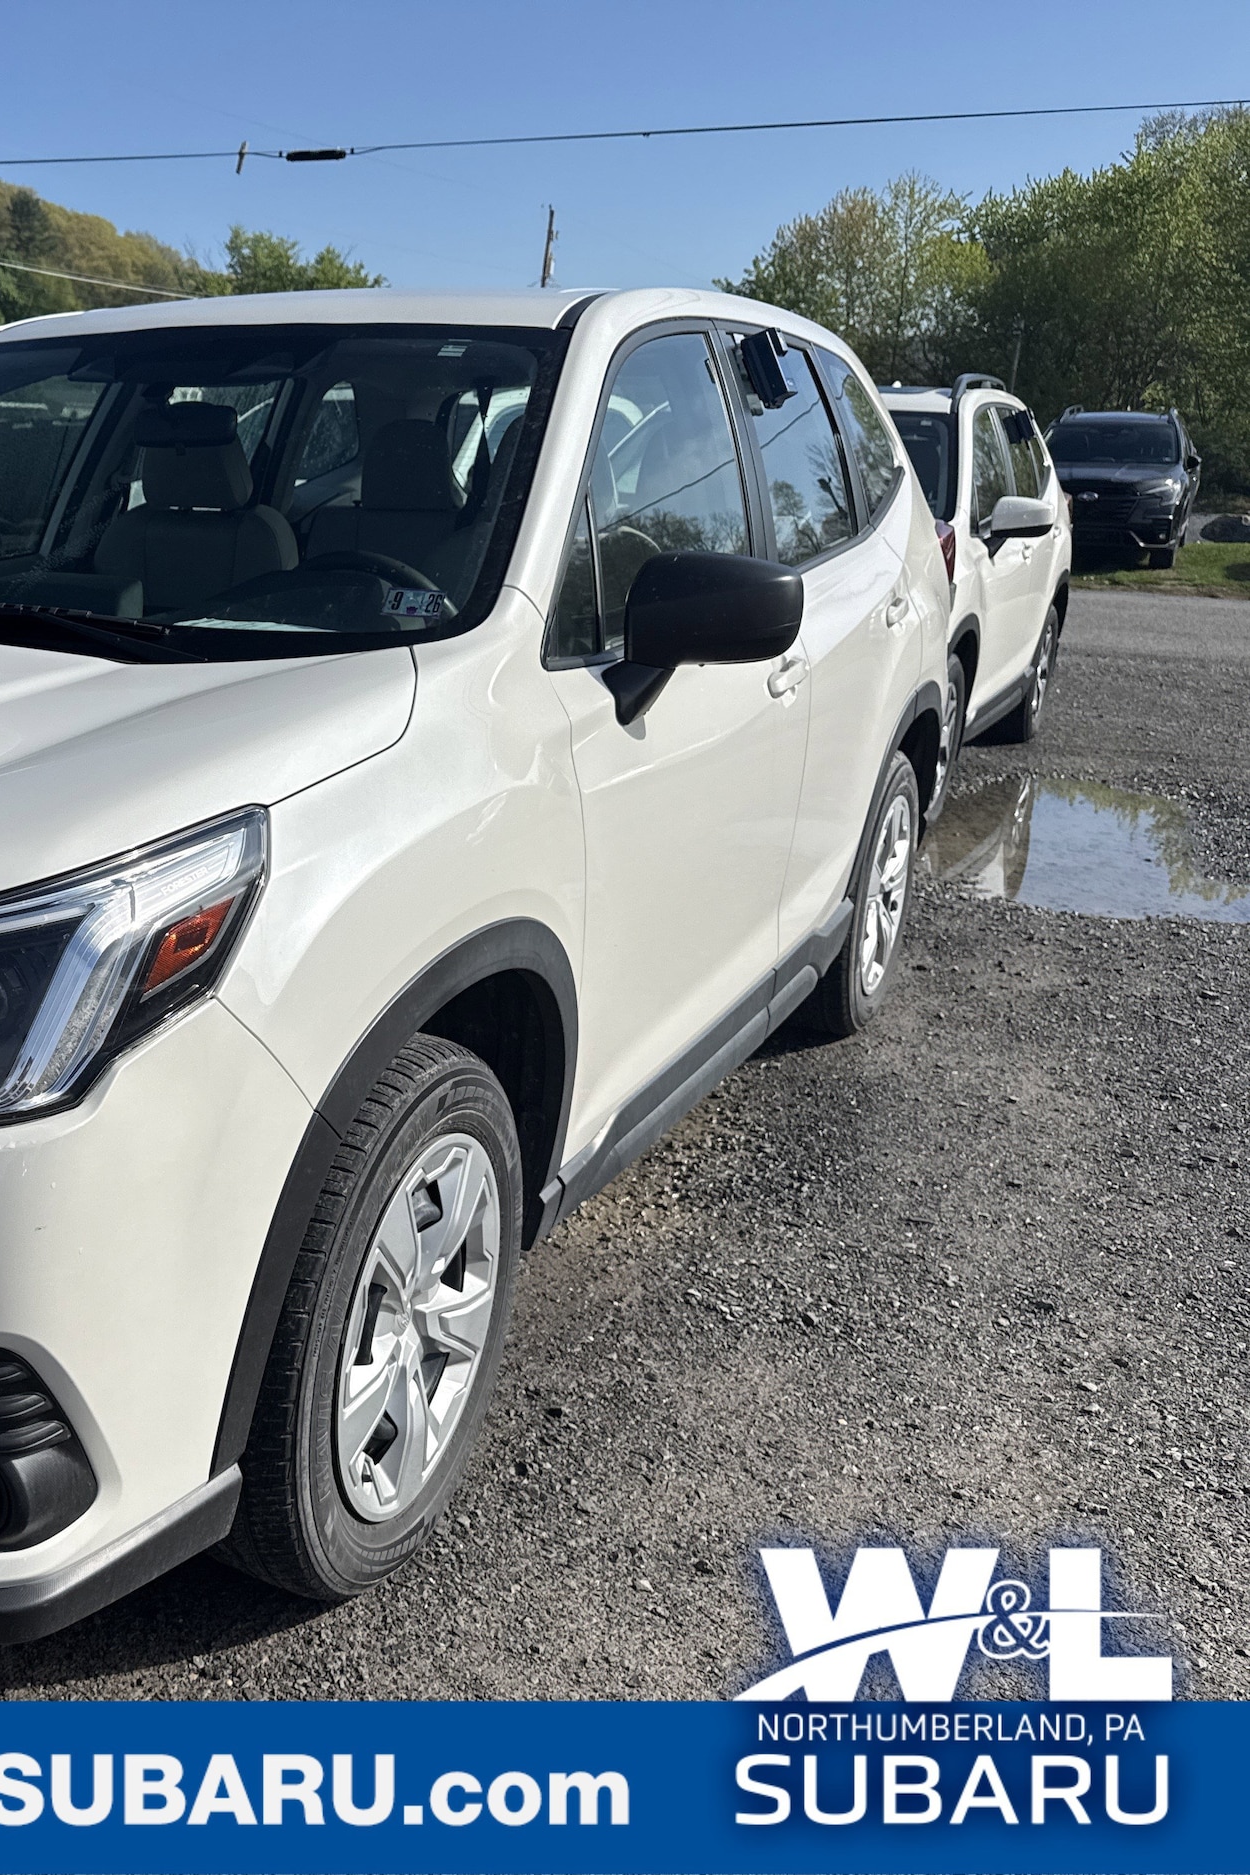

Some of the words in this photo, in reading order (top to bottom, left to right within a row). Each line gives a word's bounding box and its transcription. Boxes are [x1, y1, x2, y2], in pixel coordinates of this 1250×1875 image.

[391, 591, 404, 610] 9
[424, 593, 443, 613] 26
[161, 866, 209, 896] FORESTER
